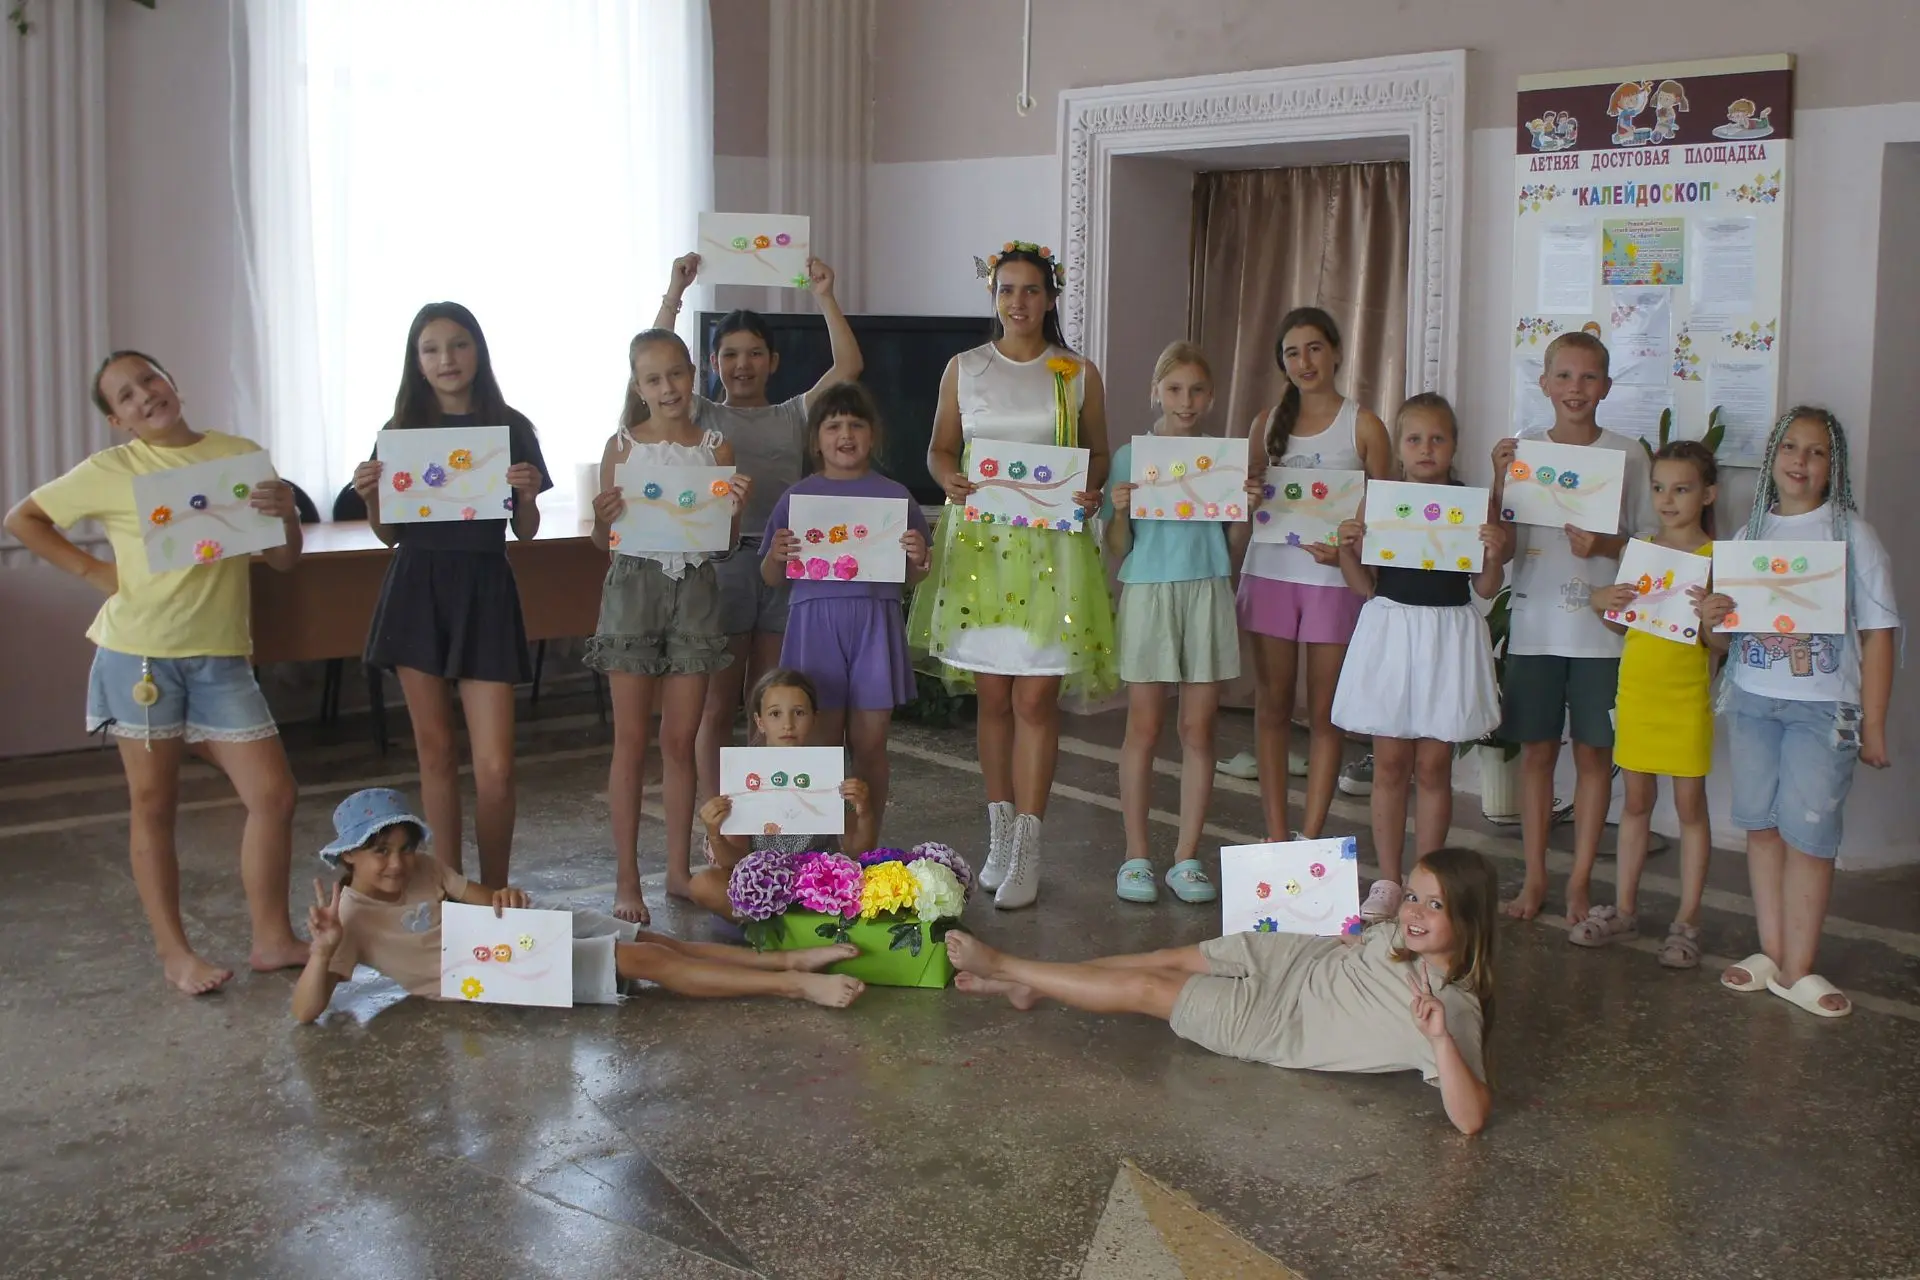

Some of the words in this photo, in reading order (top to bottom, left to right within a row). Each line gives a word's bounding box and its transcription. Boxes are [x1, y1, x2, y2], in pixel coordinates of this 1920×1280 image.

[1529, 154, 1580, 172] ЛЕТНЯЯ
[1591, 148, 1670, 172] ДОСУГОВАЯ
[1685, 143, 1767, 164] ПЛОЩАДКА
